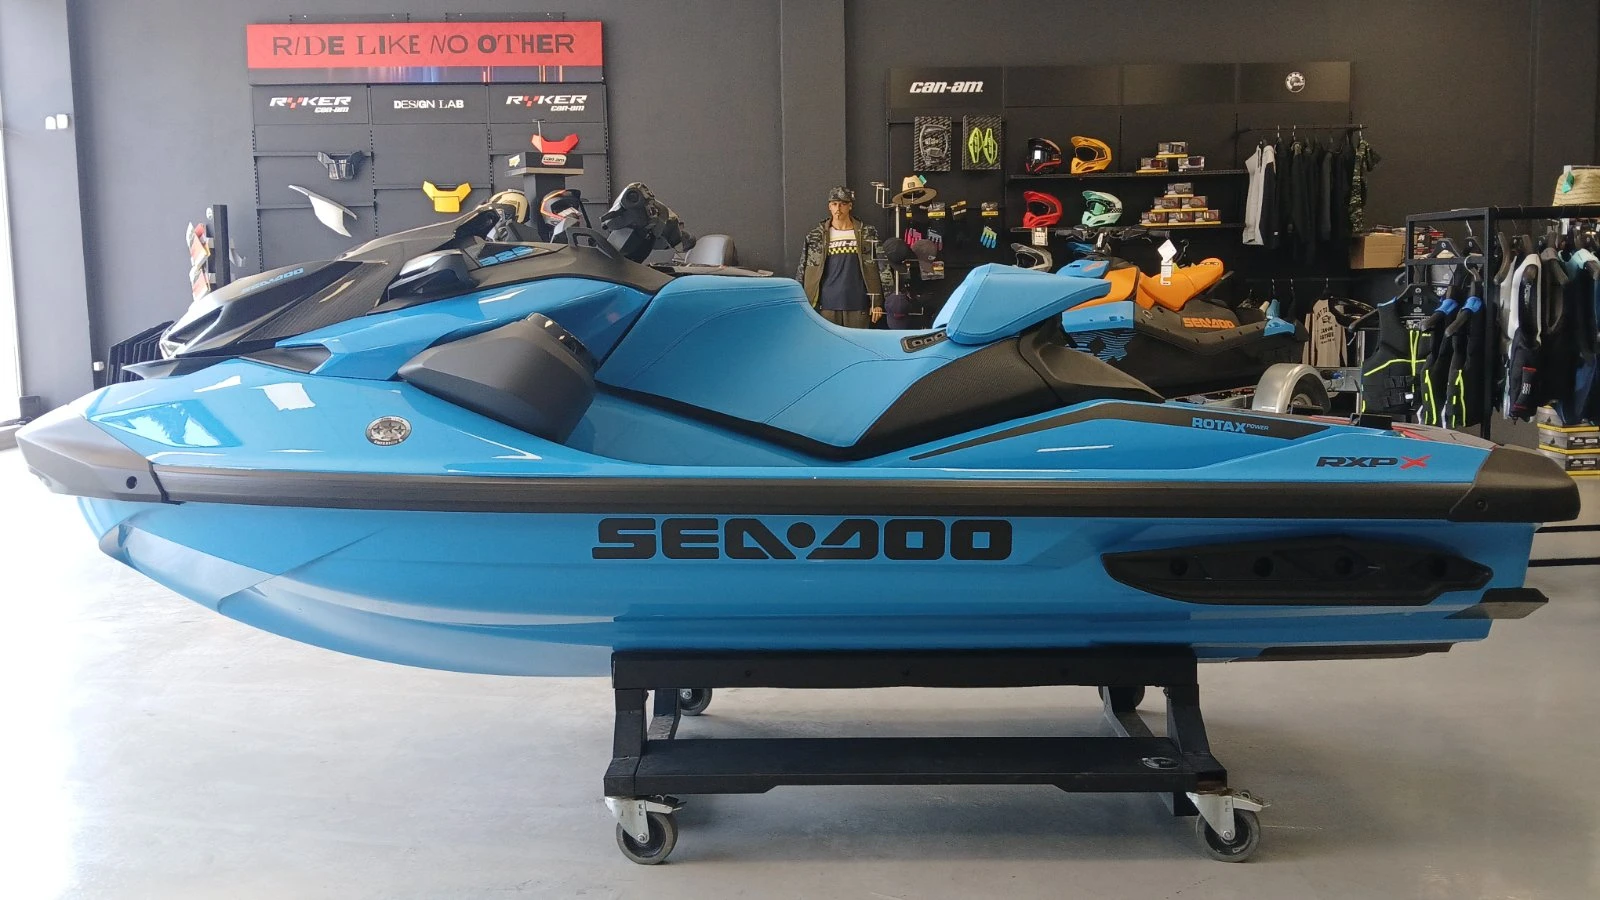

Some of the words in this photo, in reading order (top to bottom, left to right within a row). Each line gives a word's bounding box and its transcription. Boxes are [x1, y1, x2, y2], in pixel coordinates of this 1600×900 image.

[272, 35, 345, 56] RIDE
[355, 34, 421, 55] LIKE
[430, 34, 469, 54] NO
[477, 33, 576, 54] OTHER
[269, 96, 352, 109] RYKER
[393, 99, 436, 109] DESIGN
[438, 99, 465, 109] LAB
[505, 94, 588, 107] RYKER
[1192, 416, 1246, 433] ROTAX
[1246, 423, 1270, 431] POWER
